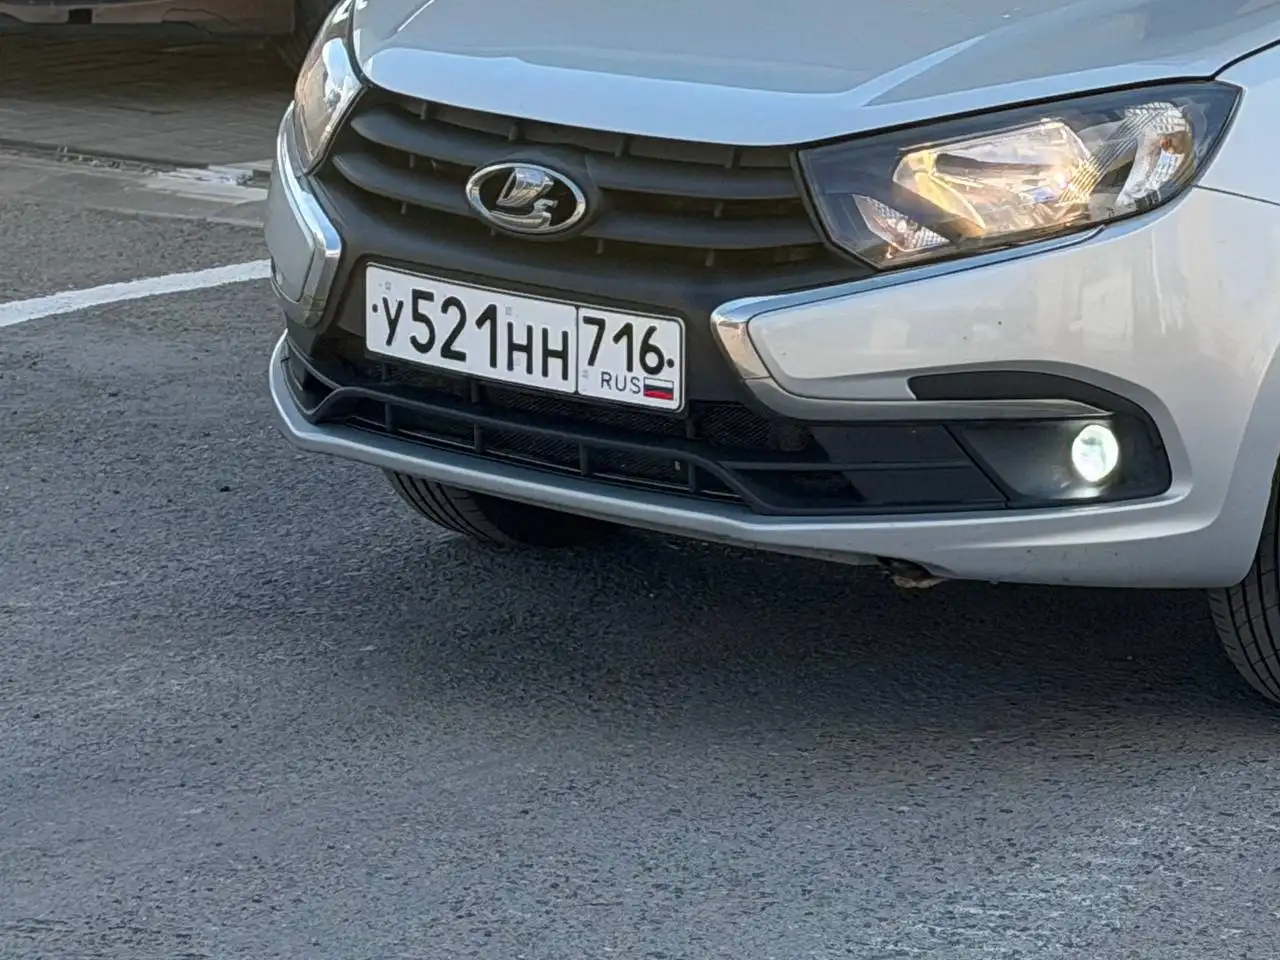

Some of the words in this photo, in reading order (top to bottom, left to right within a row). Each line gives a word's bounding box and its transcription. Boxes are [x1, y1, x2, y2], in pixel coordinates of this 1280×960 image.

[382, 288, 569, 381] У521НН
[582, 315, 665, 376] 716
[600, 371, 641, 394] RUS
